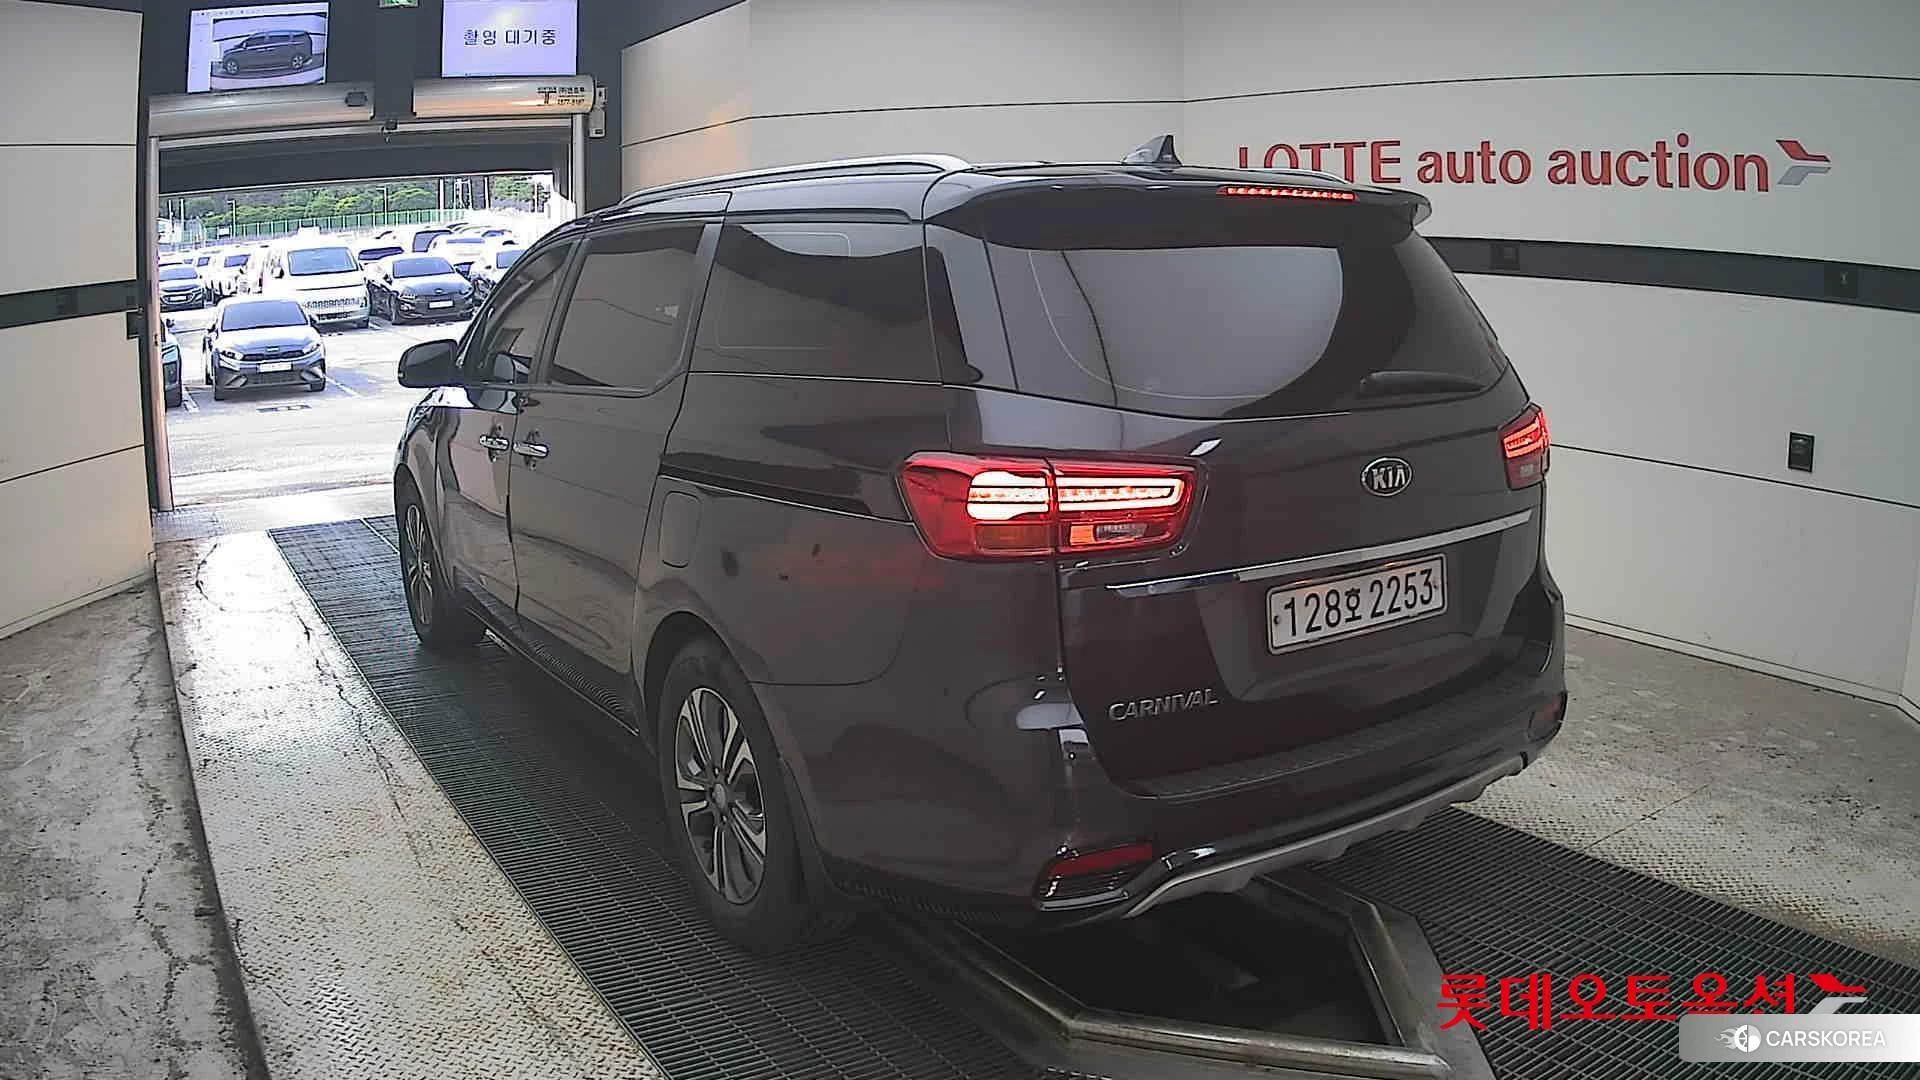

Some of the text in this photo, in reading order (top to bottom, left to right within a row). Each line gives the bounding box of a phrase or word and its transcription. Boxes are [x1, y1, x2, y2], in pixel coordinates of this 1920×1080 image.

[505, 28, 556, 46] 대기중
[1416, 140, 1532, 185] auto
[1547, 132, 1769, 193] auction
[1371, 464, 1406, 490] KIA
[1108, 688, 1218, 721] CARNIVAL
